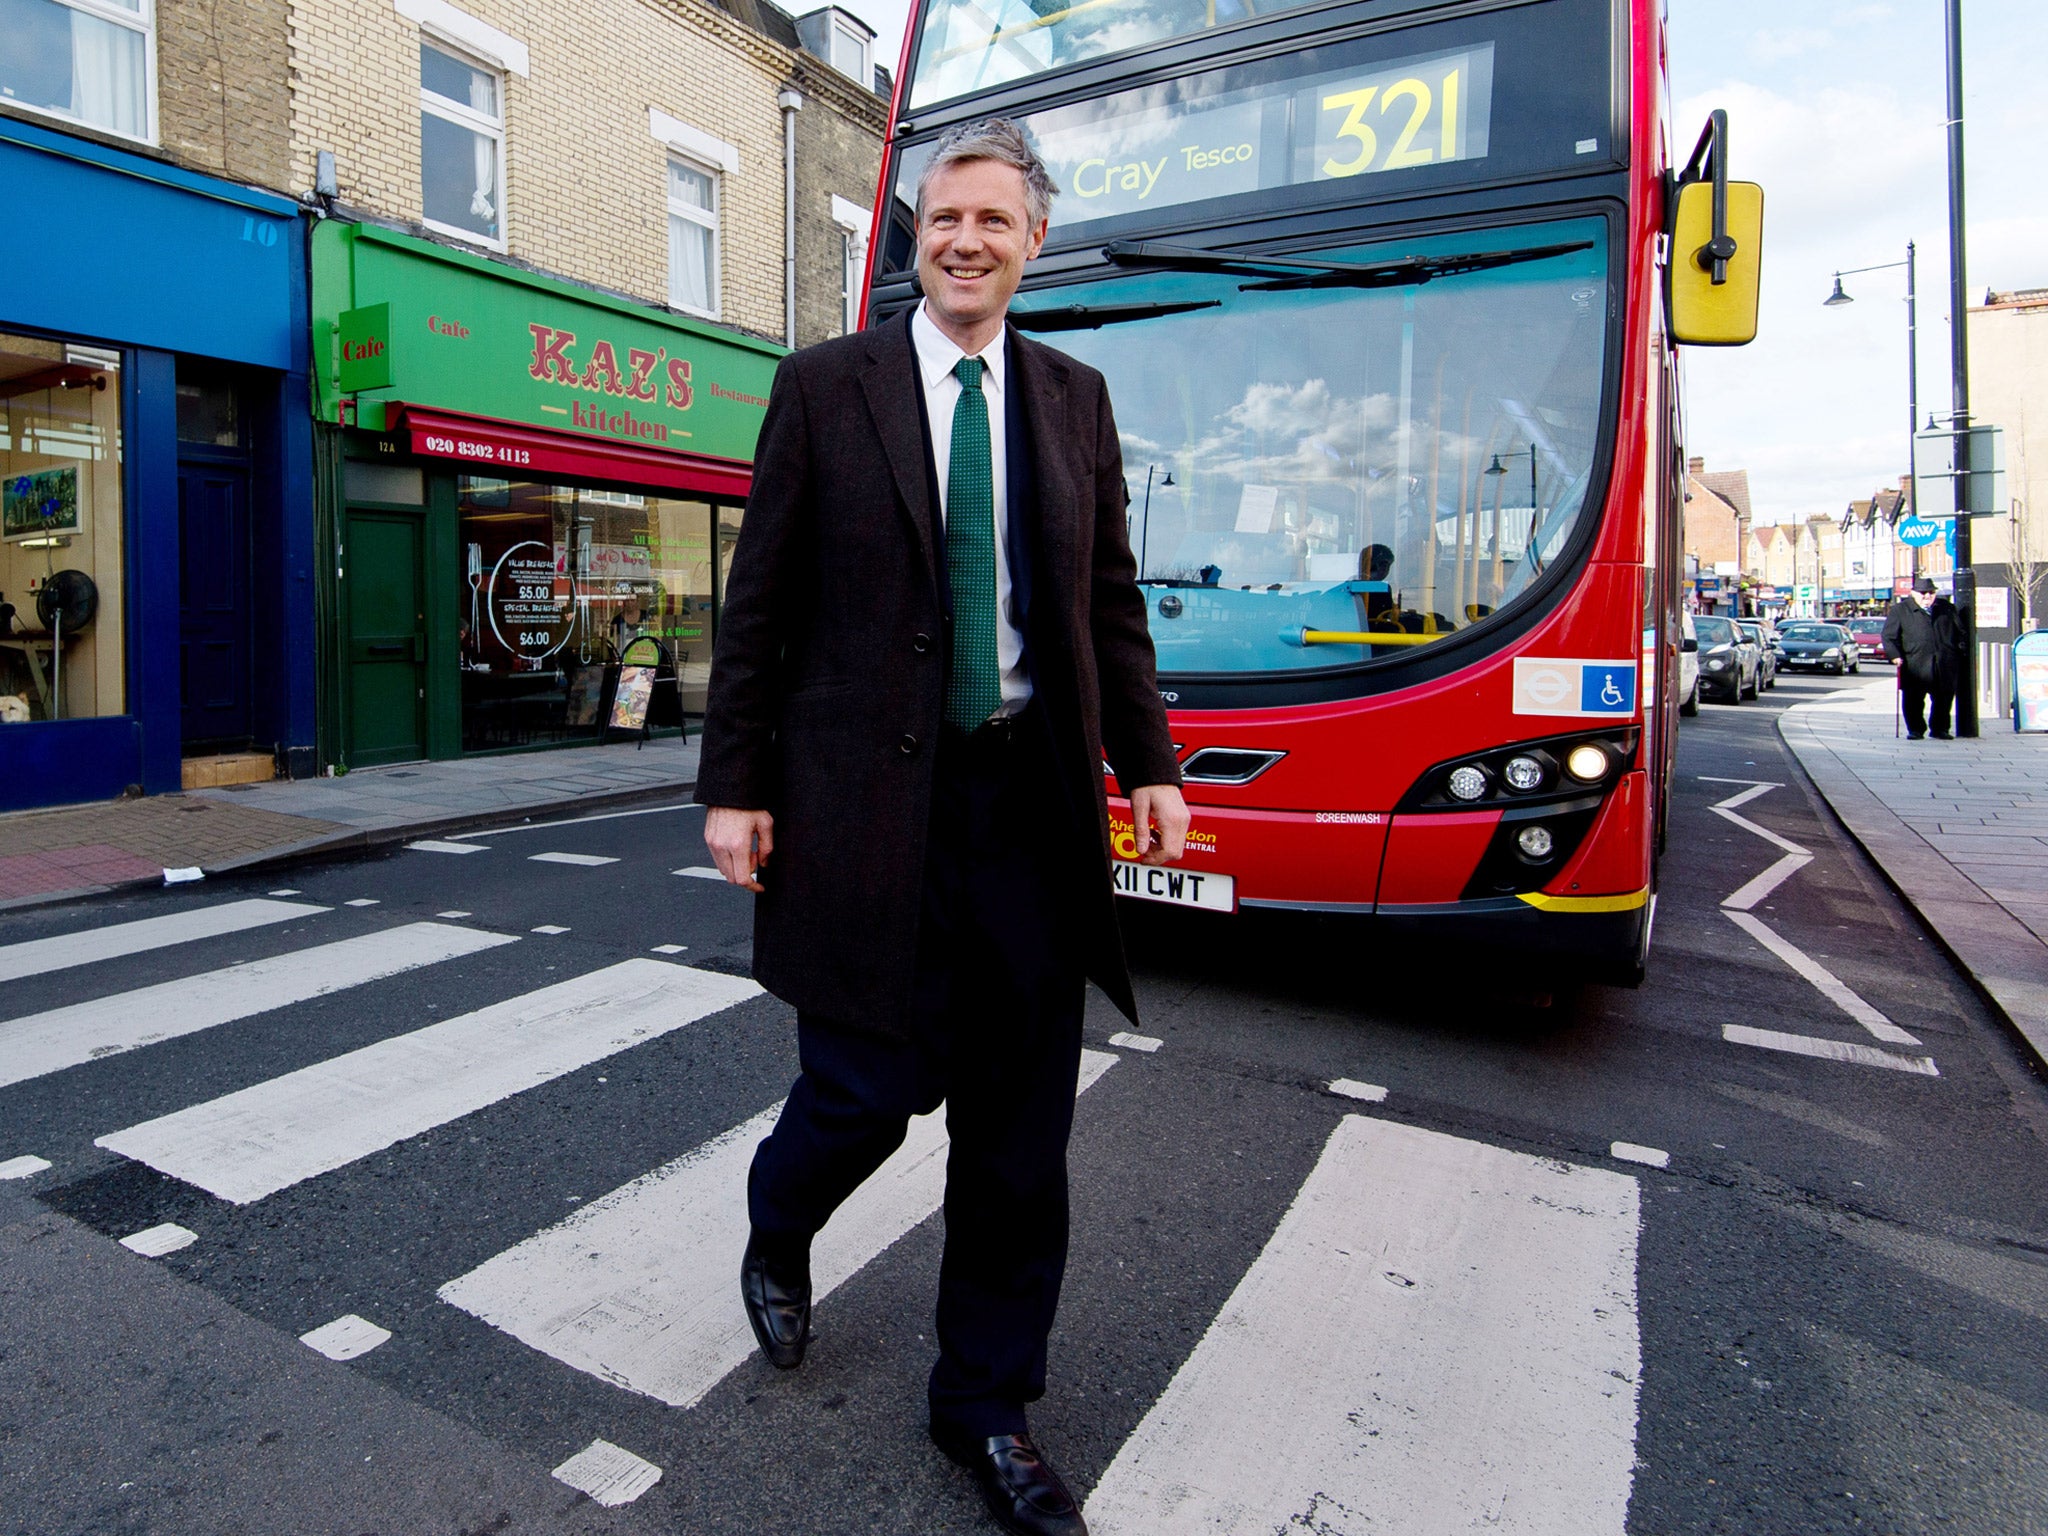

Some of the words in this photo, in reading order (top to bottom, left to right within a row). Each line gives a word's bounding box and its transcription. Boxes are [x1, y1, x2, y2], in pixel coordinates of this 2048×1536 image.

[1319, 67, 1459, 180] 321
[1073, 156, 1168, 200] Cray
[1181, 142, 1253, 171] Tesco
[239, 216, 278, 247] 10
[428, 315, 470, 339] Cafe
[343, 336, 385, 361] Cafe
[529, 323, 693, 410] KAZ'S
[710, 382, 771, 408] Restauran
[571, 400, 668, 442] kitchen
[379, 440, 395, 453] 12A
[426, 436, 454, 453] 020
[458, 440, 493, 459] 8302
[497, 448, 530, 464] 4113
[519, 586, 549, 599] £5.00
[520, 632, 549, 645] £6.00
[675, 627, 703, 637] Dinner
[1315, 812, 1381, 824] SCREENWASH
[1184, 840, 1217, 853] ENTRAL
[1113, 864, 1138, 892] X11
[1147, 869, 1205, 902] CWT
